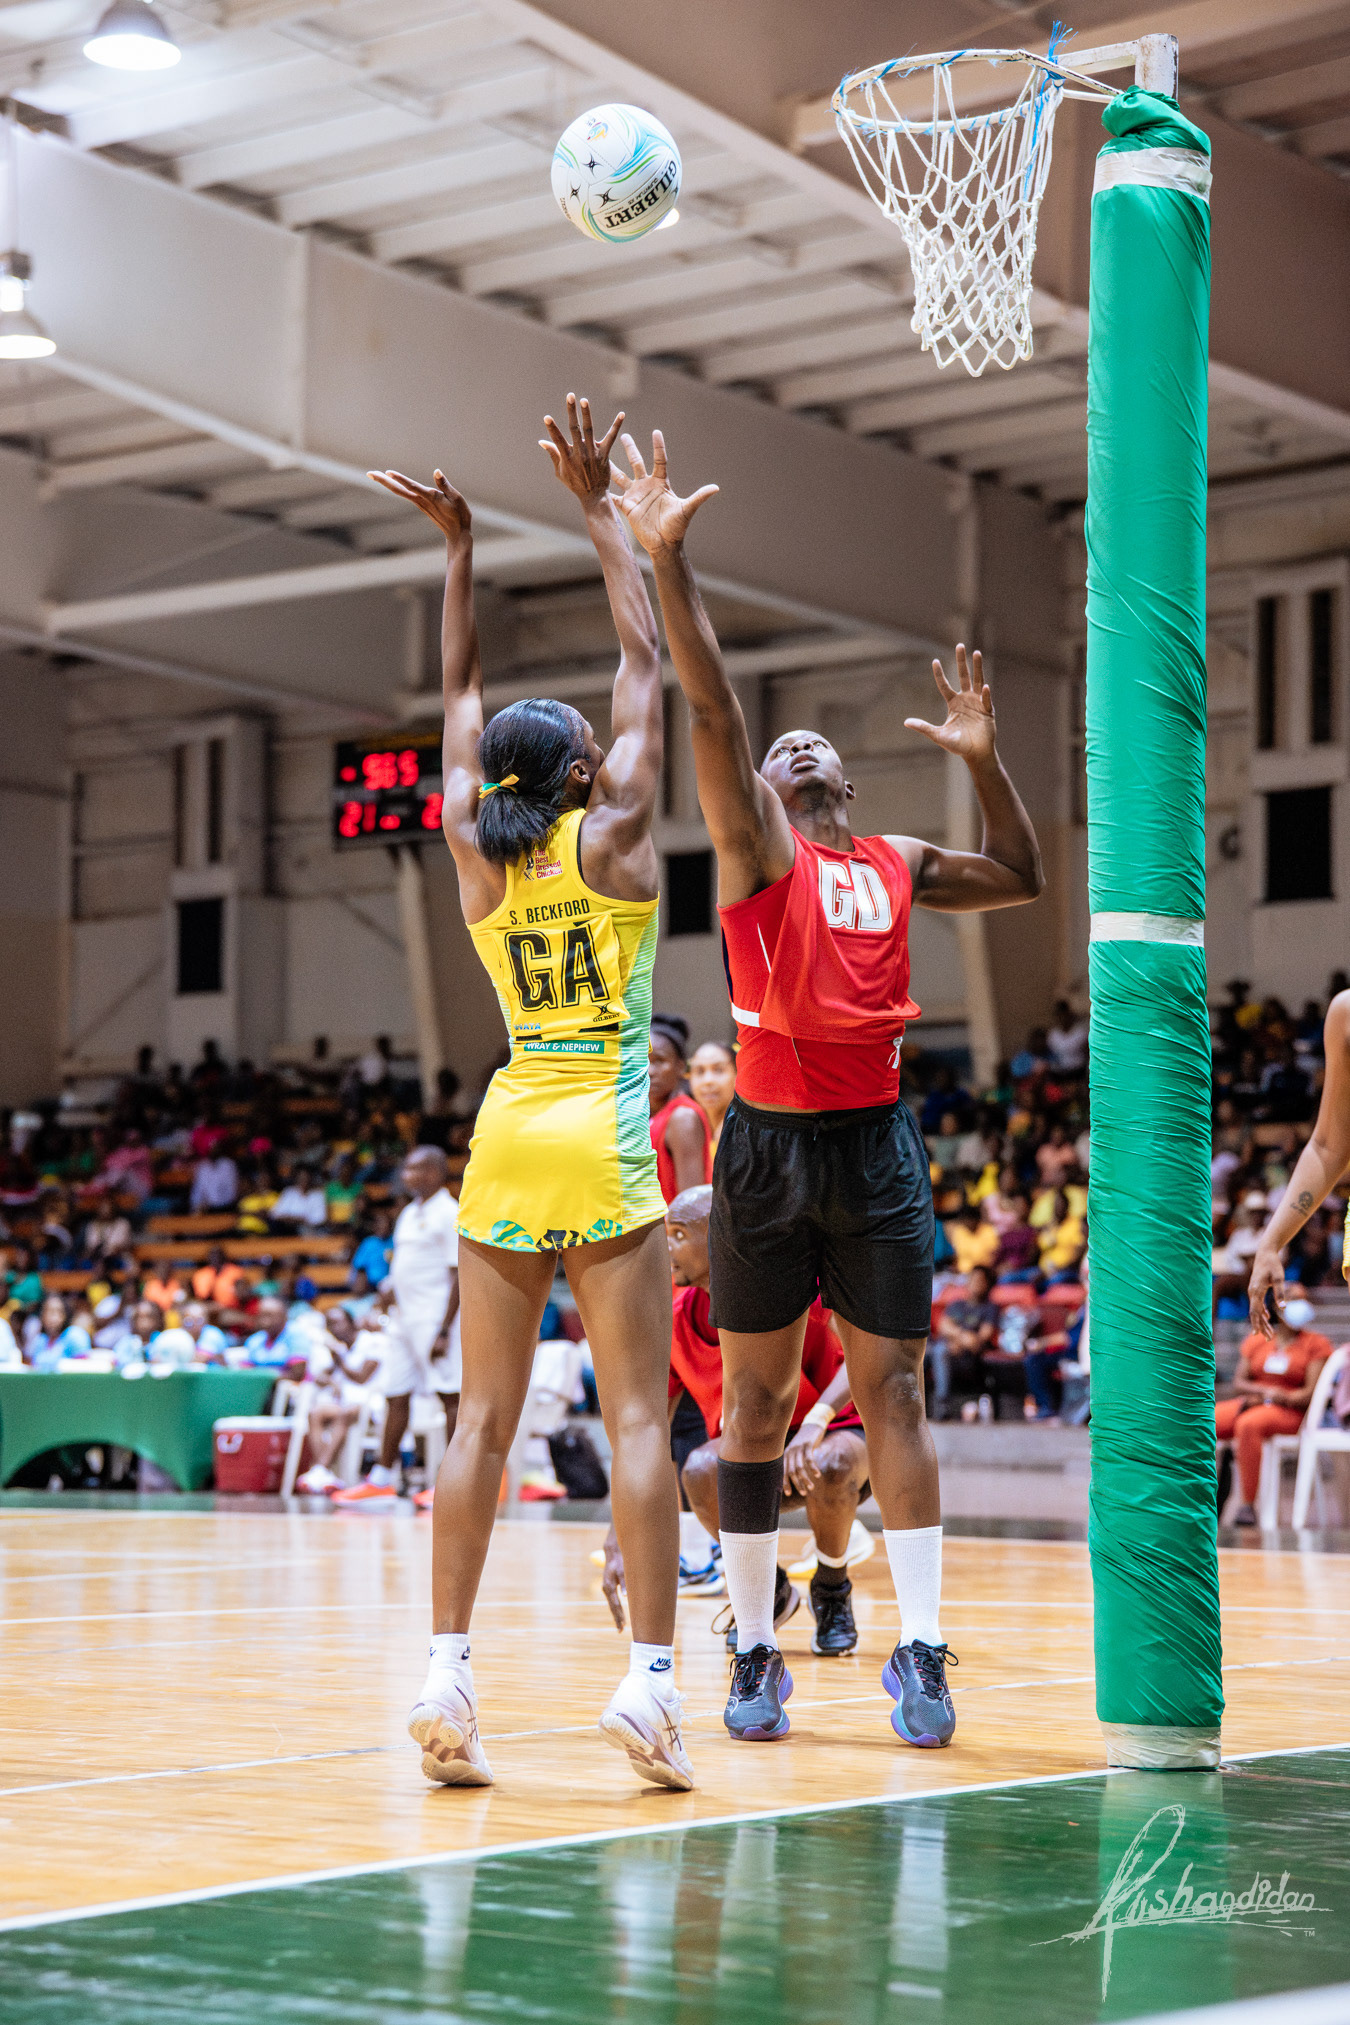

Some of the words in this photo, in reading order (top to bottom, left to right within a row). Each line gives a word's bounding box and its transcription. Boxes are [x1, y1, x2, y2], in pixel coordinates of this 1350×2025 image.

[604, 160, 677, 229] GILBERT
[509, 910, 522, 925] S.
[526, 898, 591, 924] BECKFORD
[818, 856, 893, 932] GD
[504, 923, 611, 1013] GA
[593, 1013, 620, 1023] GILBERT
[527, 1042, 550, 1050] WRAY
[552, 1043, 560, 1051] &
[561, 1042, 600, 1052] NEPHEW
